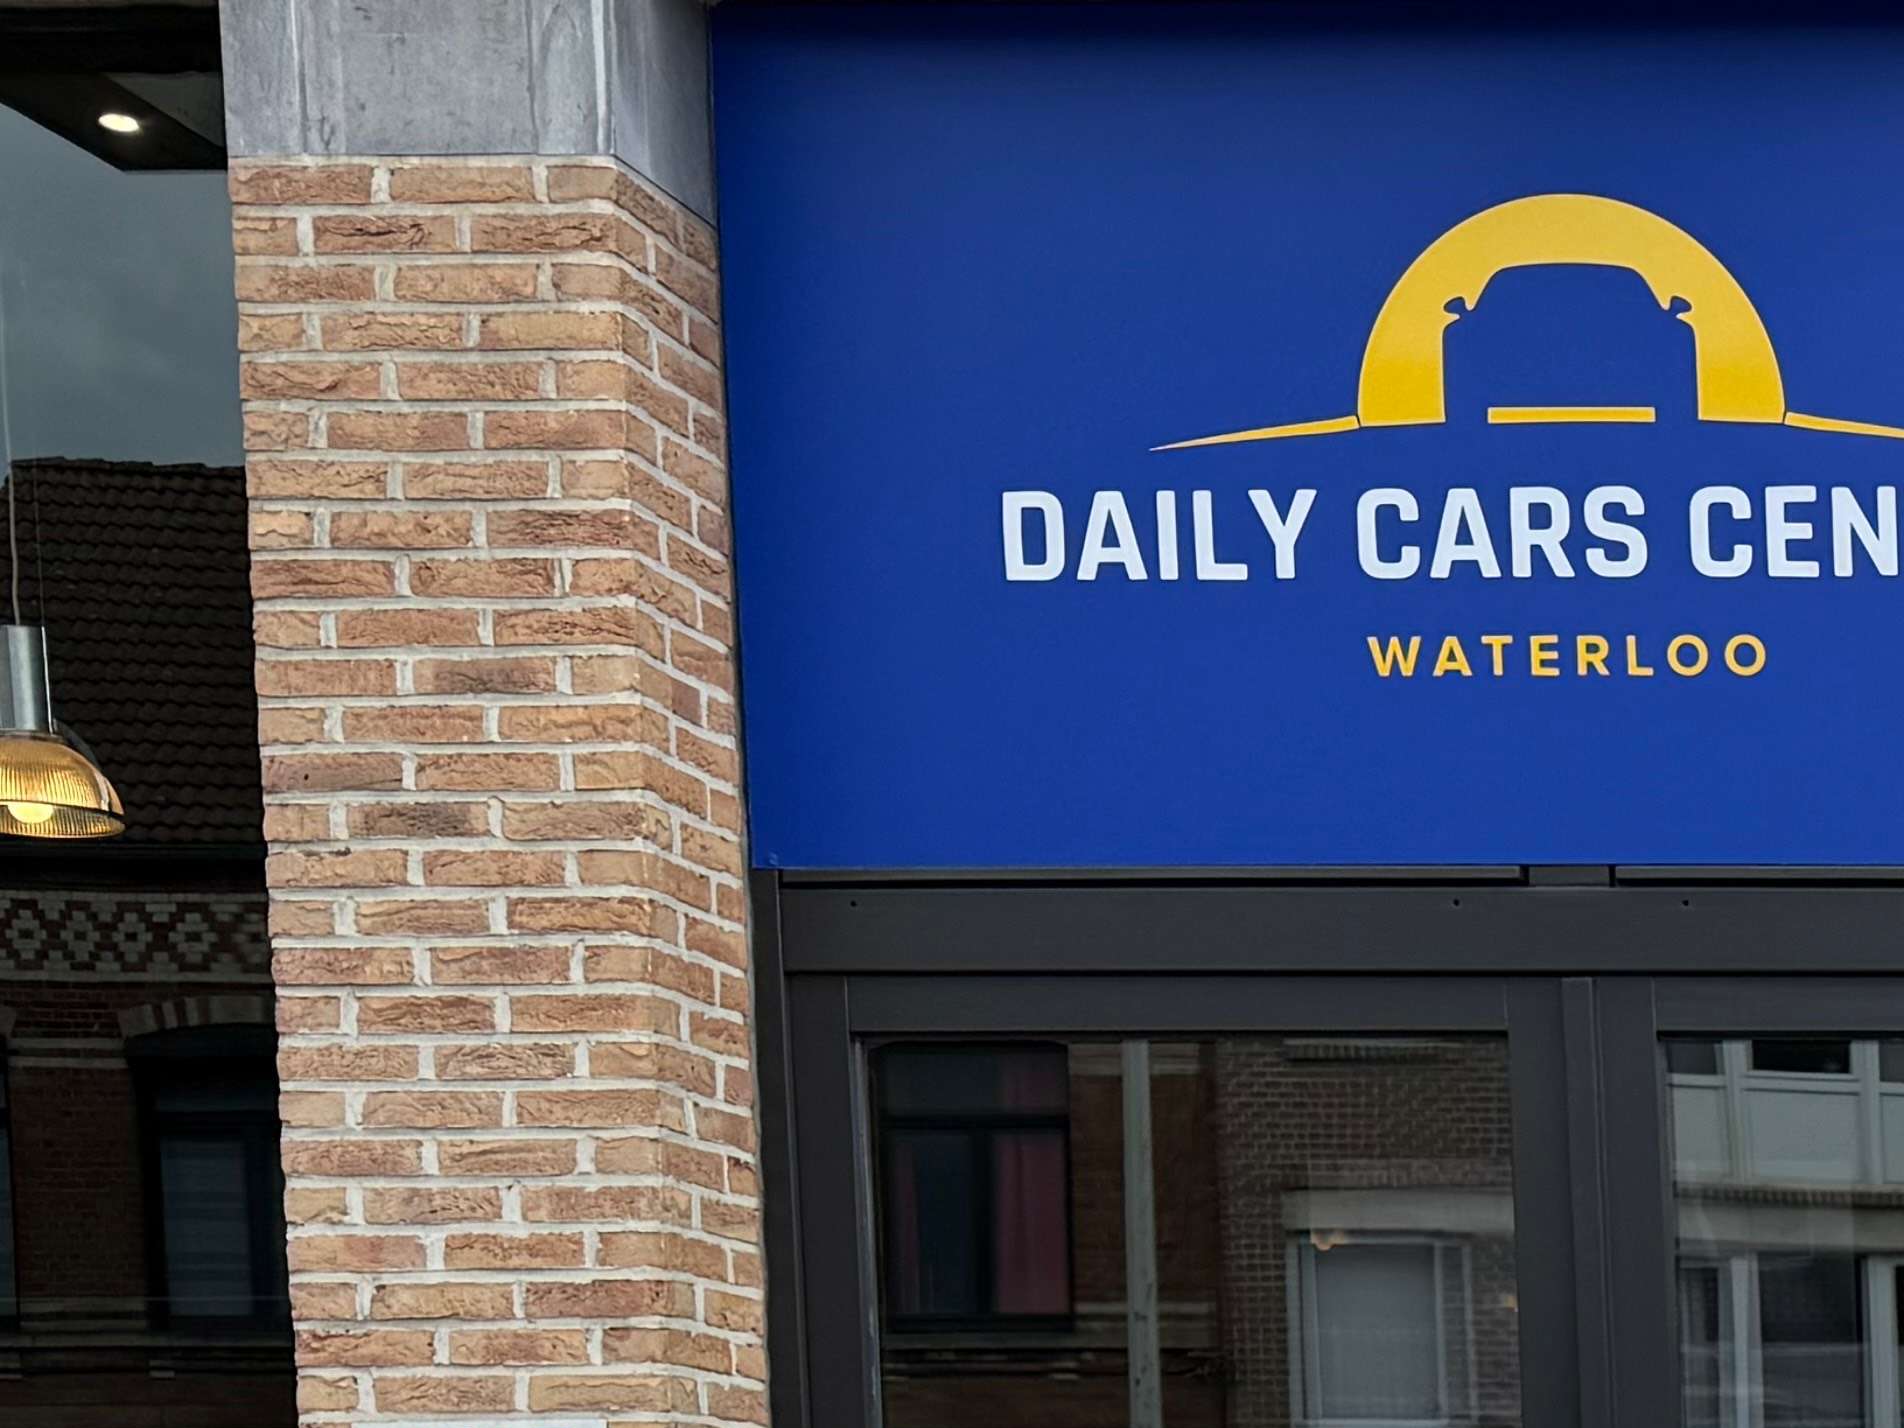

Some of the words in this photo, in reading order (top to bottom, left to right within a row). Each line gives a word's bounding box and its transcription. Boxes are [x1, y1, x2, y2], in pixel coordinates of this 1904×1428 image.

[1002, 488, 1317, 581] DAILY
[1356, 485, 1648, 579] CARS
[1367, 634, 1768, 677] WATERLOO
